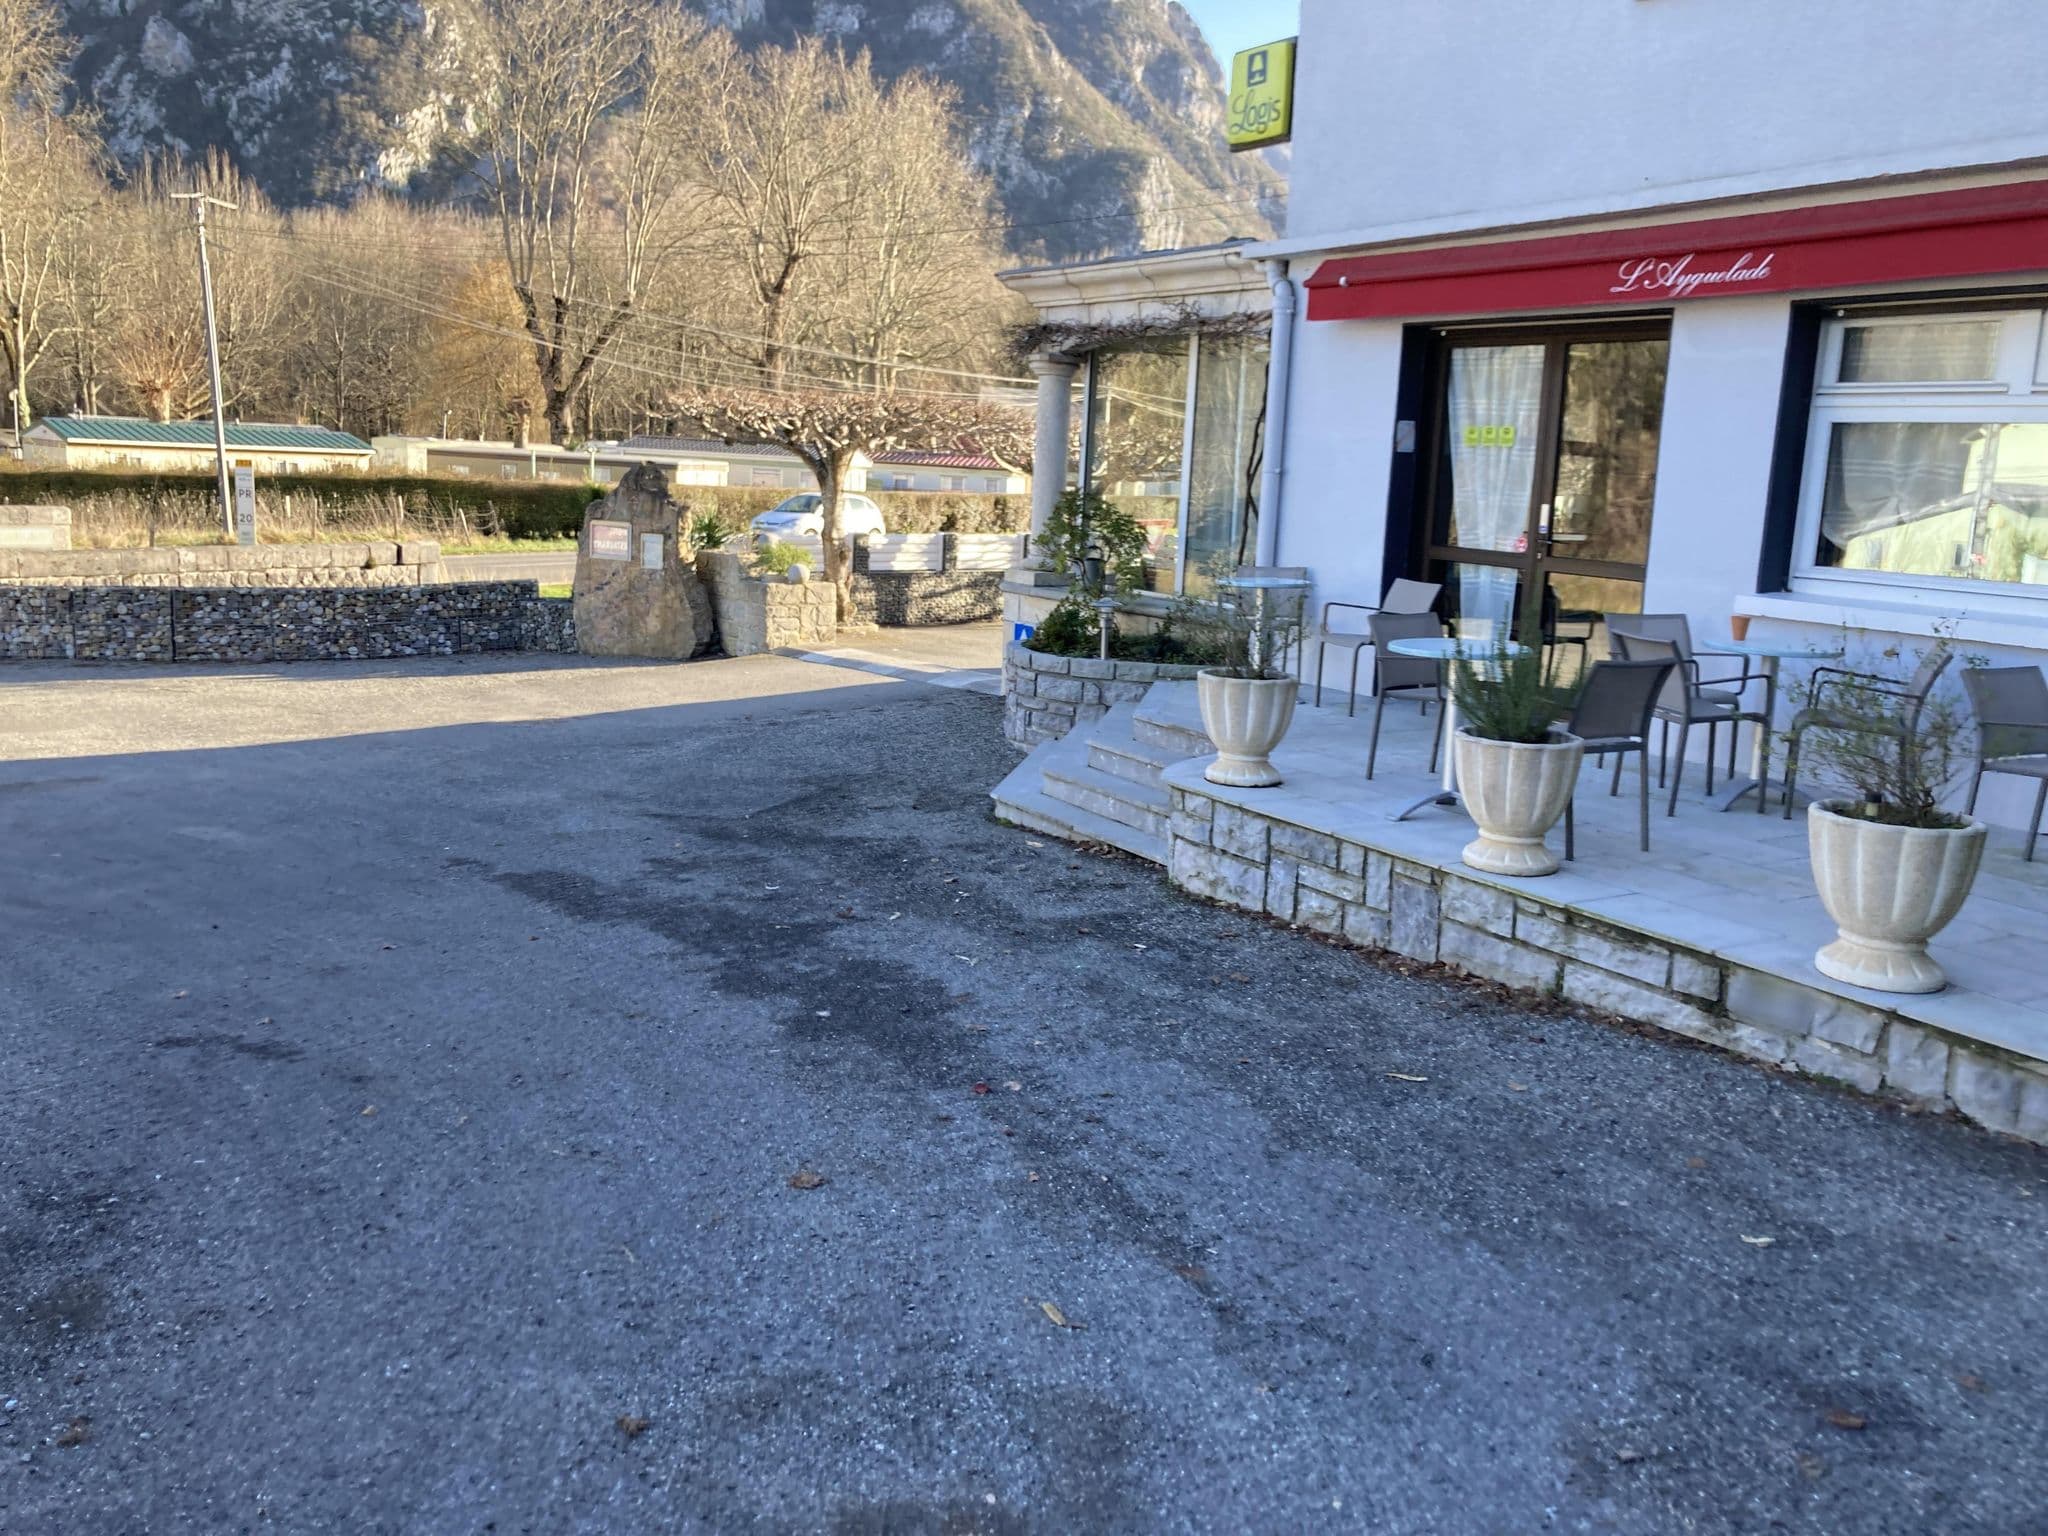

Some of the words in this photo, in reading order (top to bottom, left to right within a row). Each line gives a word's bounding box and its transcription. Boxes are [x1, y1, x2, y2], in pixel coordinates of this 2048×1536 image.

[1229, 89, 1281, 134] Logis
[1609, 252, 1775, 297] L'Ayguelade
[239, 489, 252, 498] PR
[240, 514, 252, 523] 20
